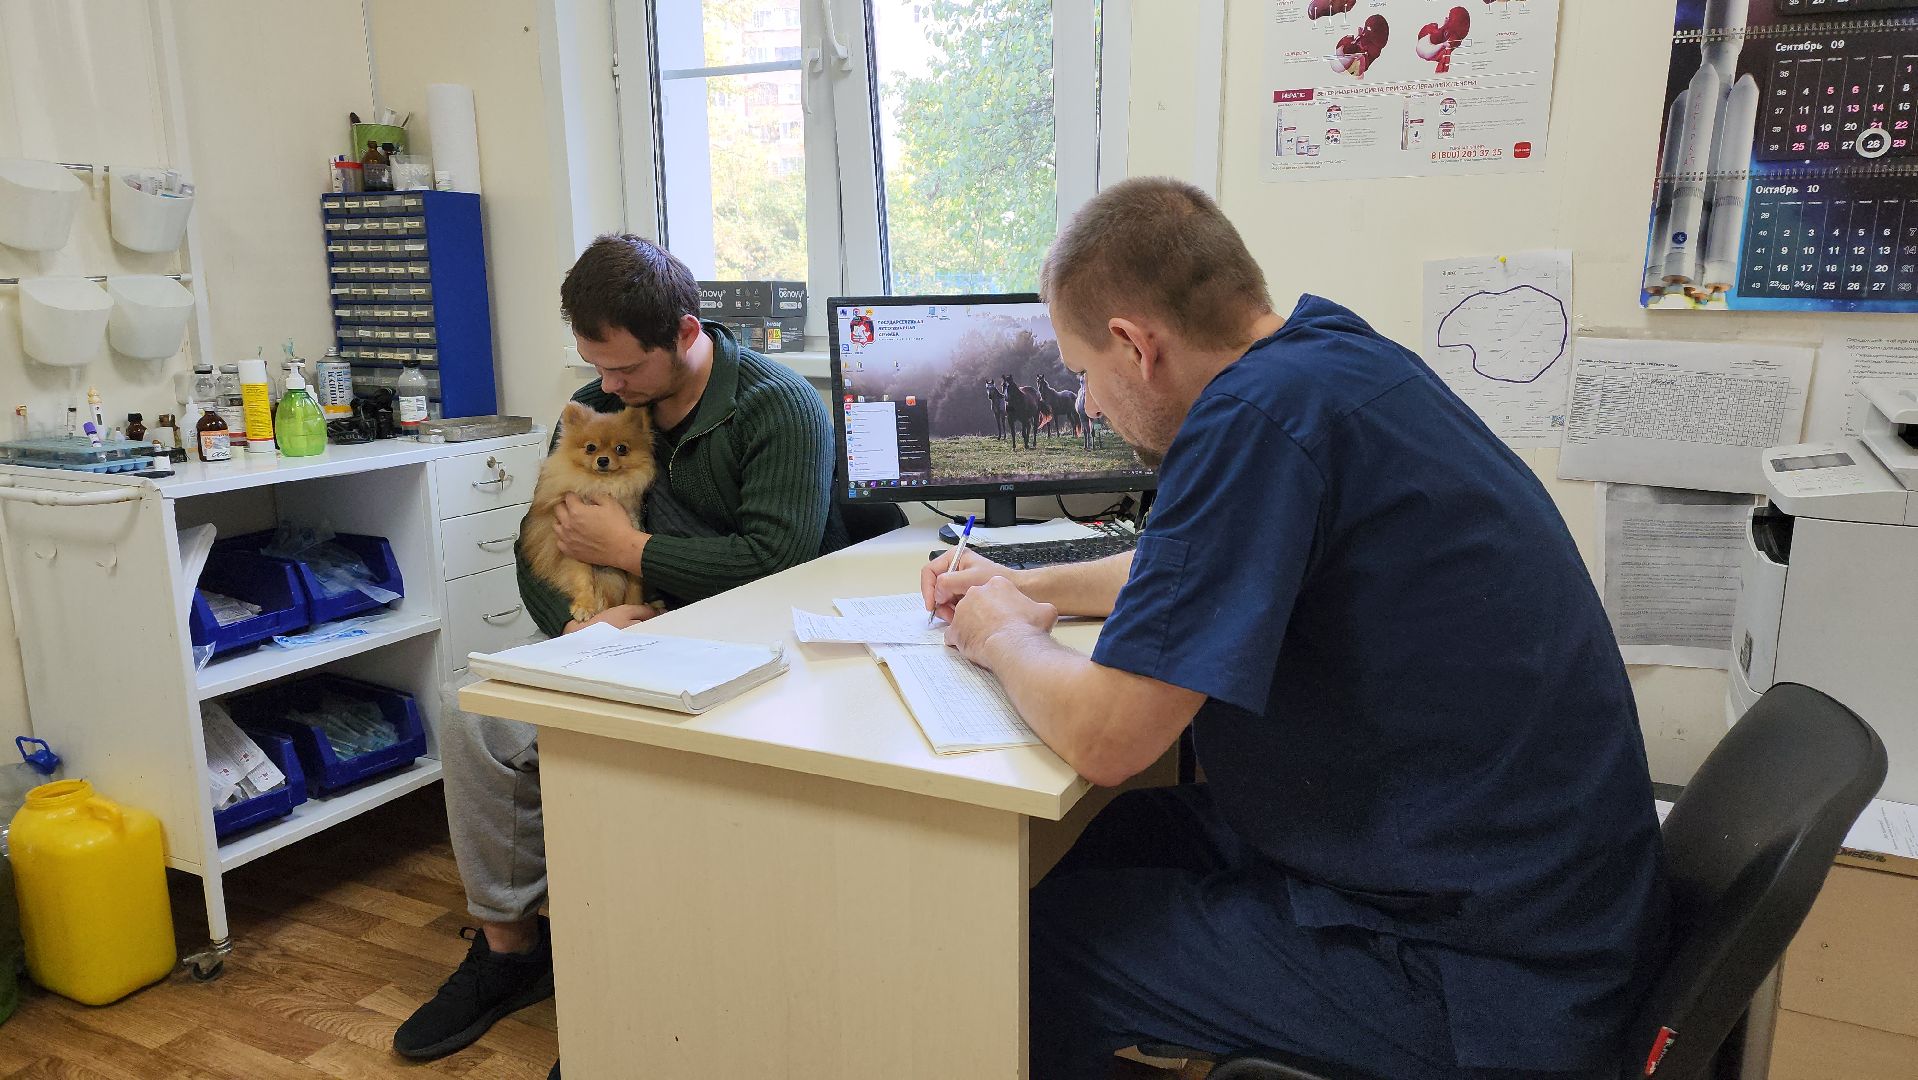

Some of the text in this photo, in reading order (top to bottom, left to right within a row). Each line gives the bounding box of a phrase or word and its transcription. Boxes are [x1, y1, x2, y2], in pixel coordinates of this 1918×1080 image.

[1776, 40, 1844, 52] Сентябрь 09
[1802, 88, 1809, 96] 4
[1799, 106, 1809, 114] 11
[1823, 105, 1834, 113] 12
[1847, 105, 1860, 113] 13
[1872, 104, 1884, 112] 14
[1844, 123, 1857, 131] 20
[1895, 121, 1909, 129] 22
[1817, 142, 1830, 150] 26
[1842, 141, 1855, 149] 27
[1867, 140, 1880, 148] 28
[1439, 151, 1459, 159] (800)
[1756, 185, 1819, 195] Октябрь 10
[1909, 228, 1917, 236] 7
[1828, 246, 1840, 254] 11
[1853, 246, 1865, 254] 12
[1879, 246, 1891, 254] 13
[1823, 282, 1836, 290] 25
[1847, 283, 1860, 291] 26
[1872, 283, 1885, 291] 27
[697, 290, 723, 301] enovy
